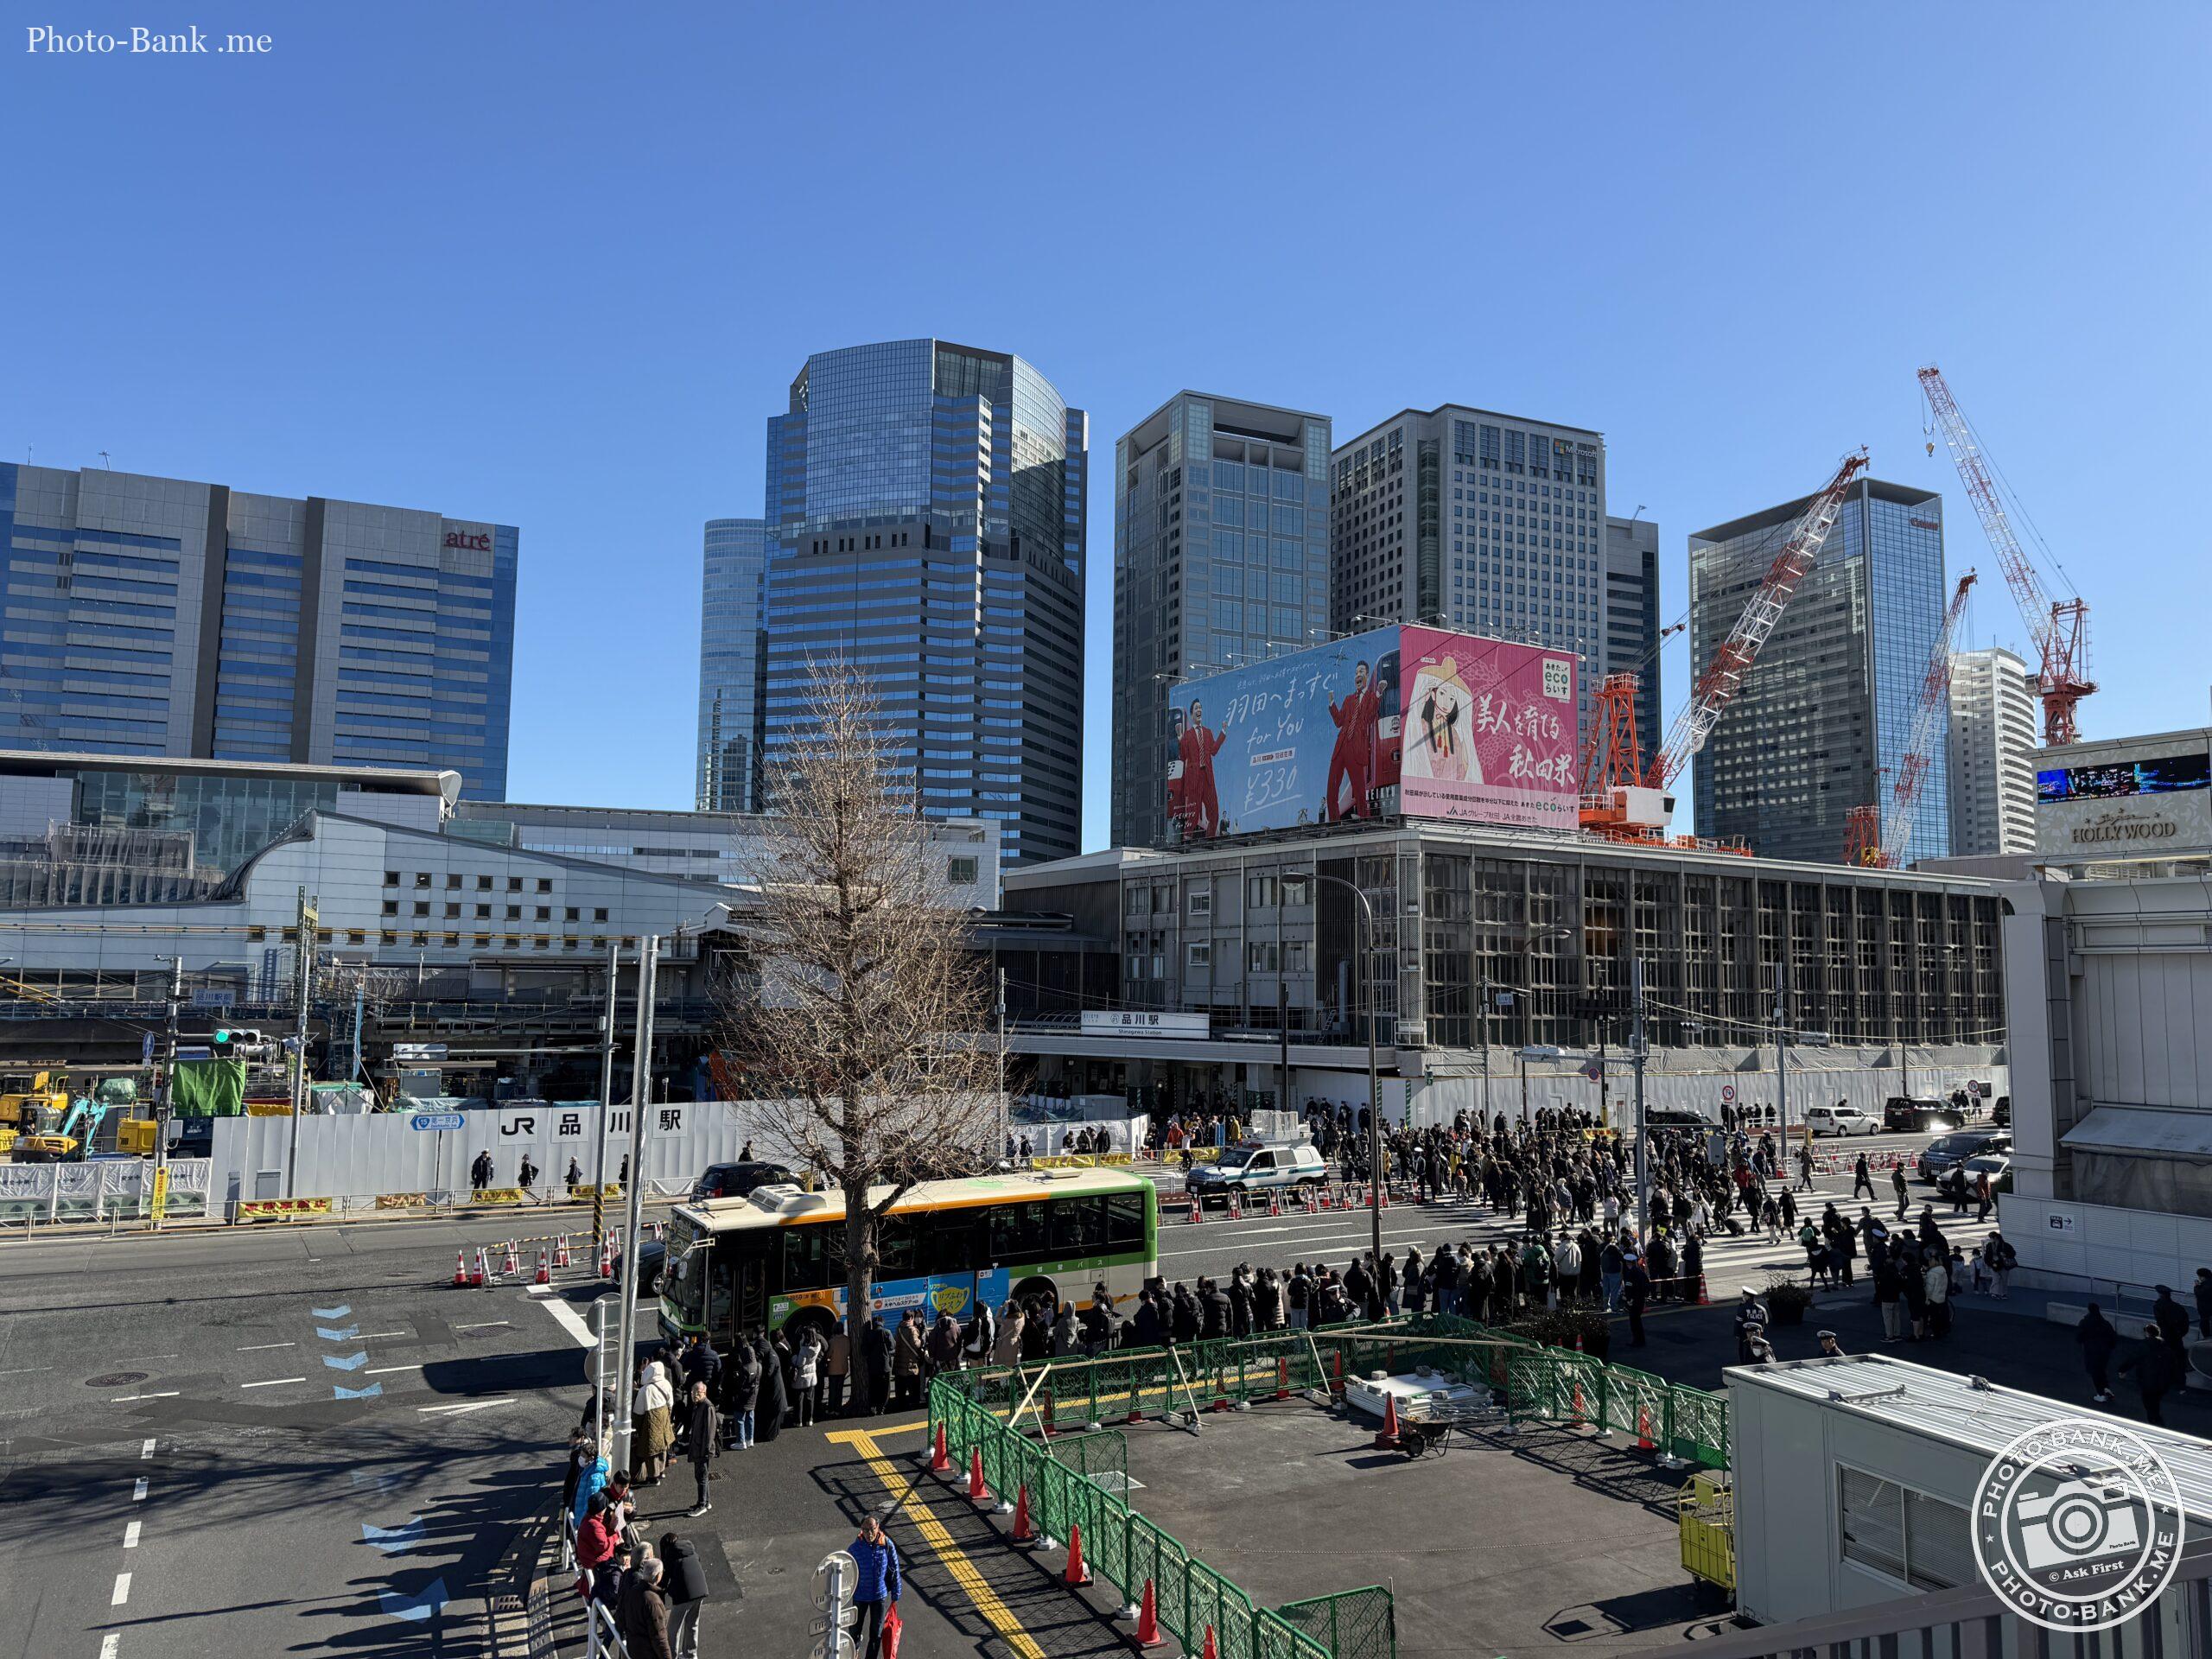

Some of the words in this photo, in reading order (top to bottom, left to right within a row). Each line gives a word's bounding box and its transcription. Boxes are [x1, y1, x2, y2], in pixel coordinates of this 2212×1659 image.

[445, 530, 492, 551] atré
[1545, 671, 1568, 684] eco
[1225, 671, 1338, 728] 羽田へまっすぐ
[1545, 683, 1568, 696] らいす
[1477, 693, 1560, 741] 美人を育てる
[1246, 727, 1272, 754] for
[1509, 744, 1576, 787] 秋田米
[2072, 822, 2177, 844] HOLLYWOOD
[1122, 1014, 1160, 1026] 品川駅
[501, 1116, 536, 1136] JR
